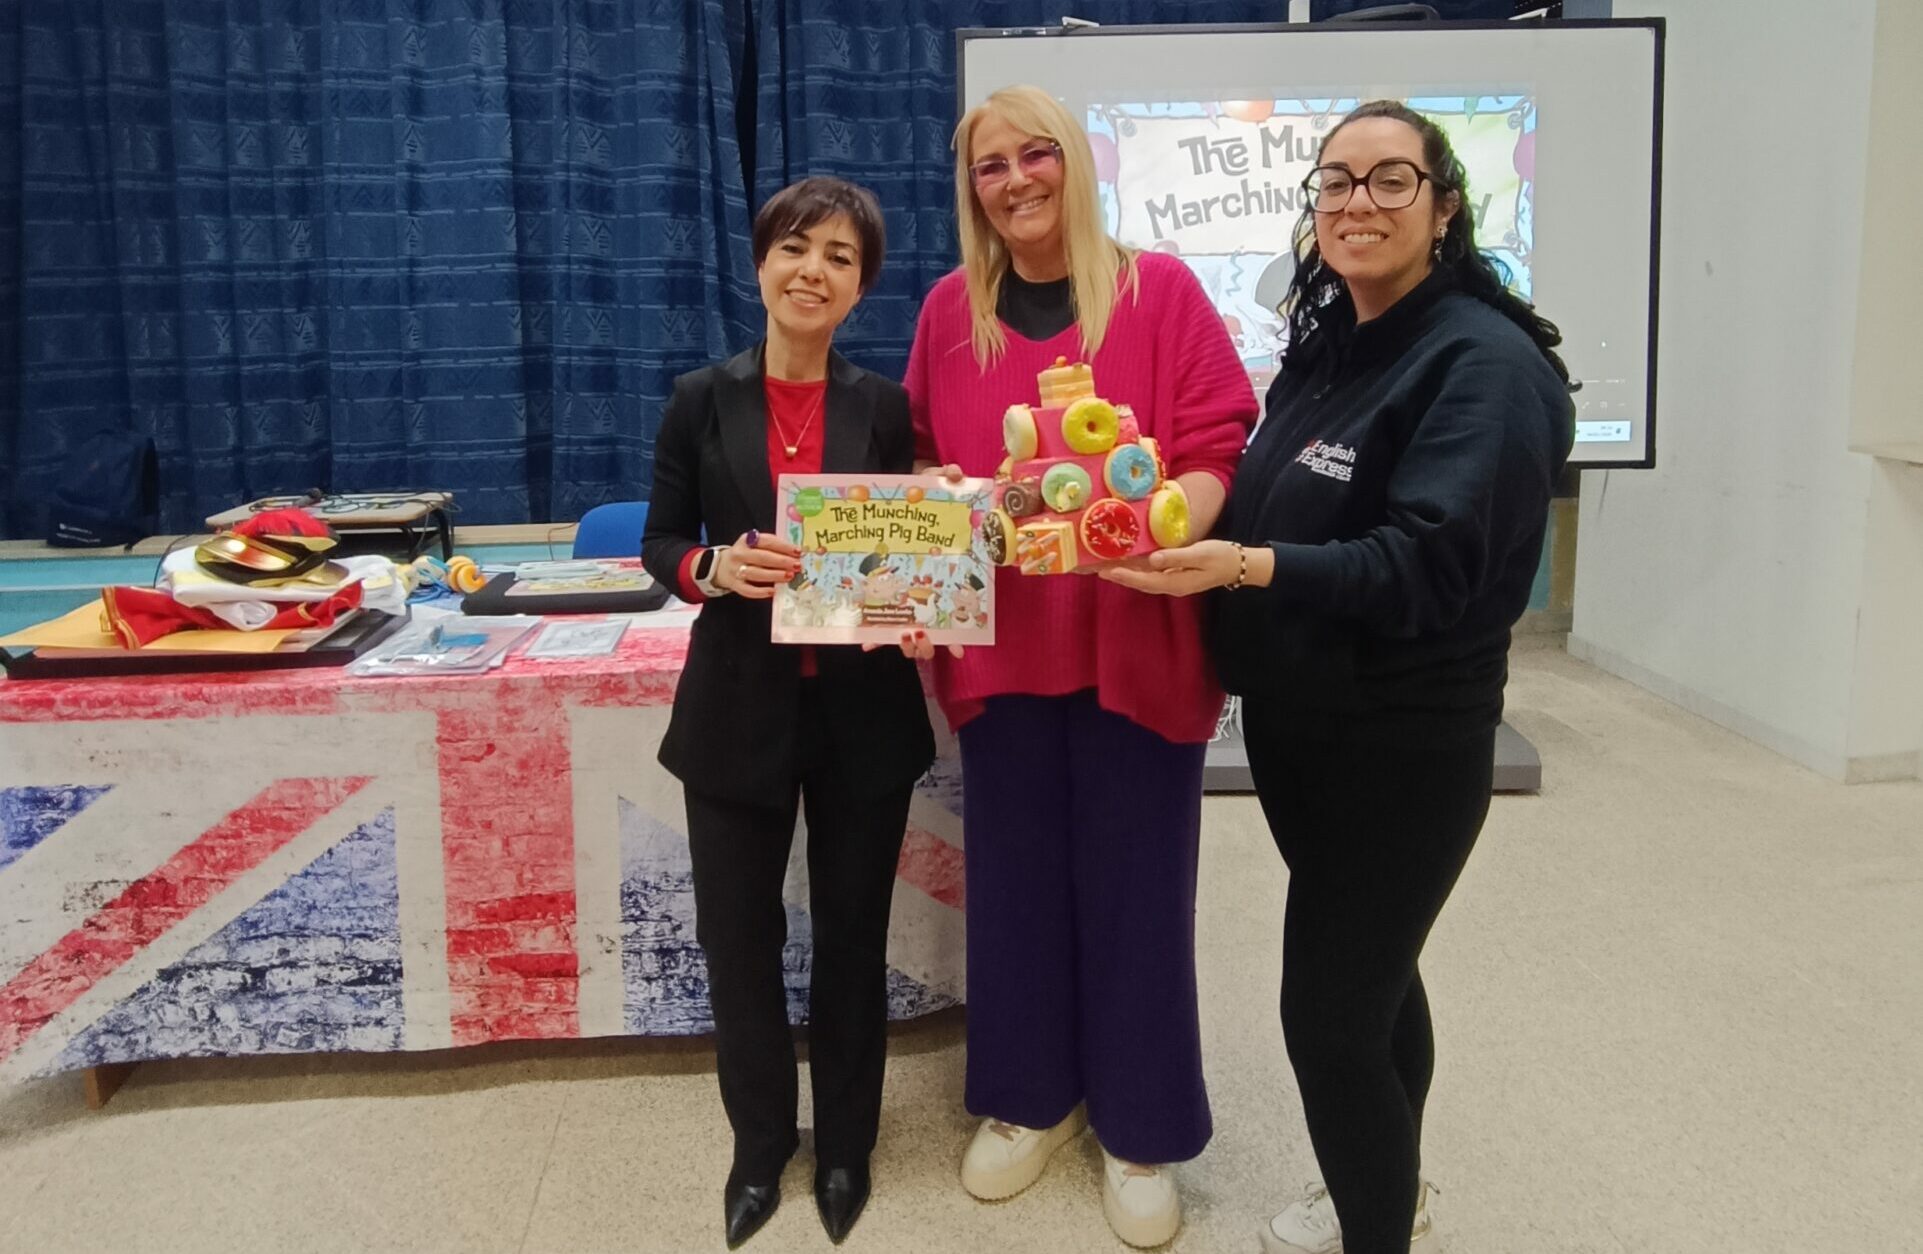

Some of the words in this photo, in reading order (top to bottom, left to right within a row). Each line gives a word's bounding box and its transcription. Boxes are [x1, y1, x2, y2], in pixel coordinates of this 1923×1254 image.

[1177, 135, 1250, 177] The
[1311, 439, 1357, 463] English
[1301, 451, 1354, 478] Express
[830, 506, 858, 523] The
[862, 503, 940, 527] Munching,
[815, 524, 885, 548] Marching
[889, 522, 912, 543] Pig
[916, 525, 956, 547] Band
